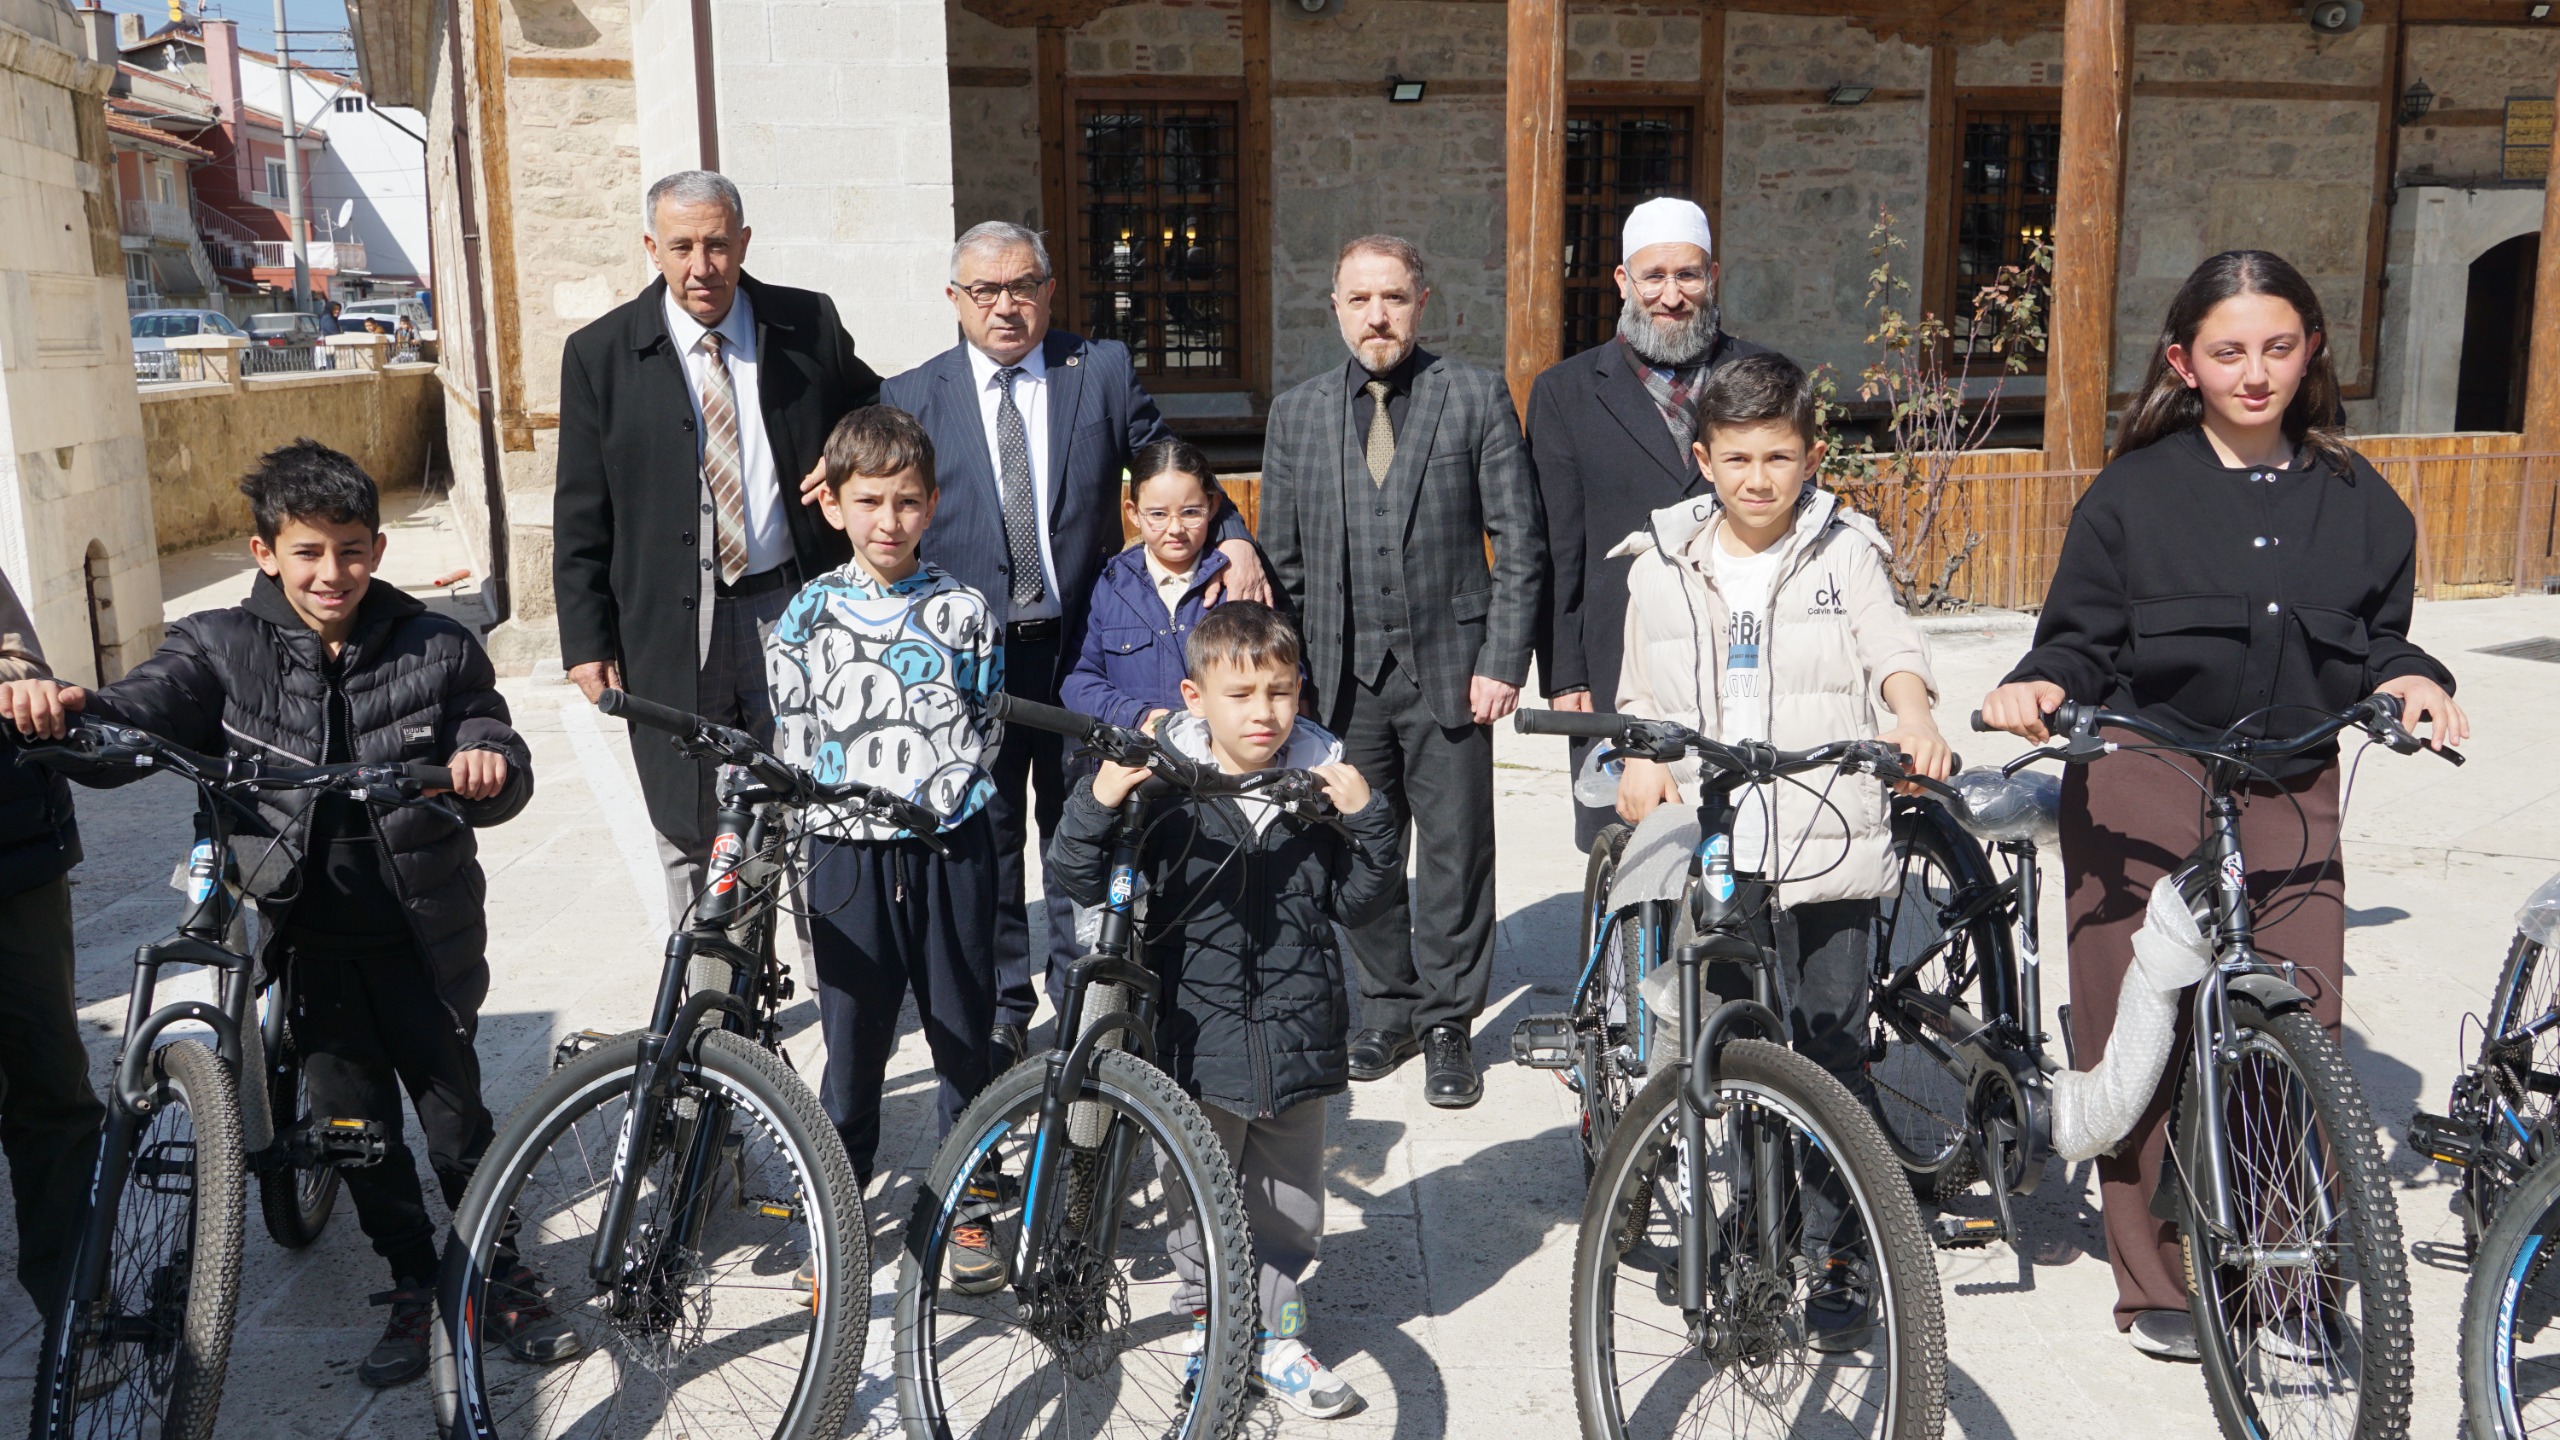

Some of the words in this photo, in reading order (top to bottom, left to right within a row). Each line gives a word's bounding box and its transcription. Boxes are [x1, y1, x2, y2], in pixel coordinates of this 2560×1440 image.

[1807, 607, 1831, 615] Calvin
[1240, 774, 1263, 789] arnica
[2182, 1233, 2200, 1297] Mitas
[2496, 1277, 2519, 1390] arnica
